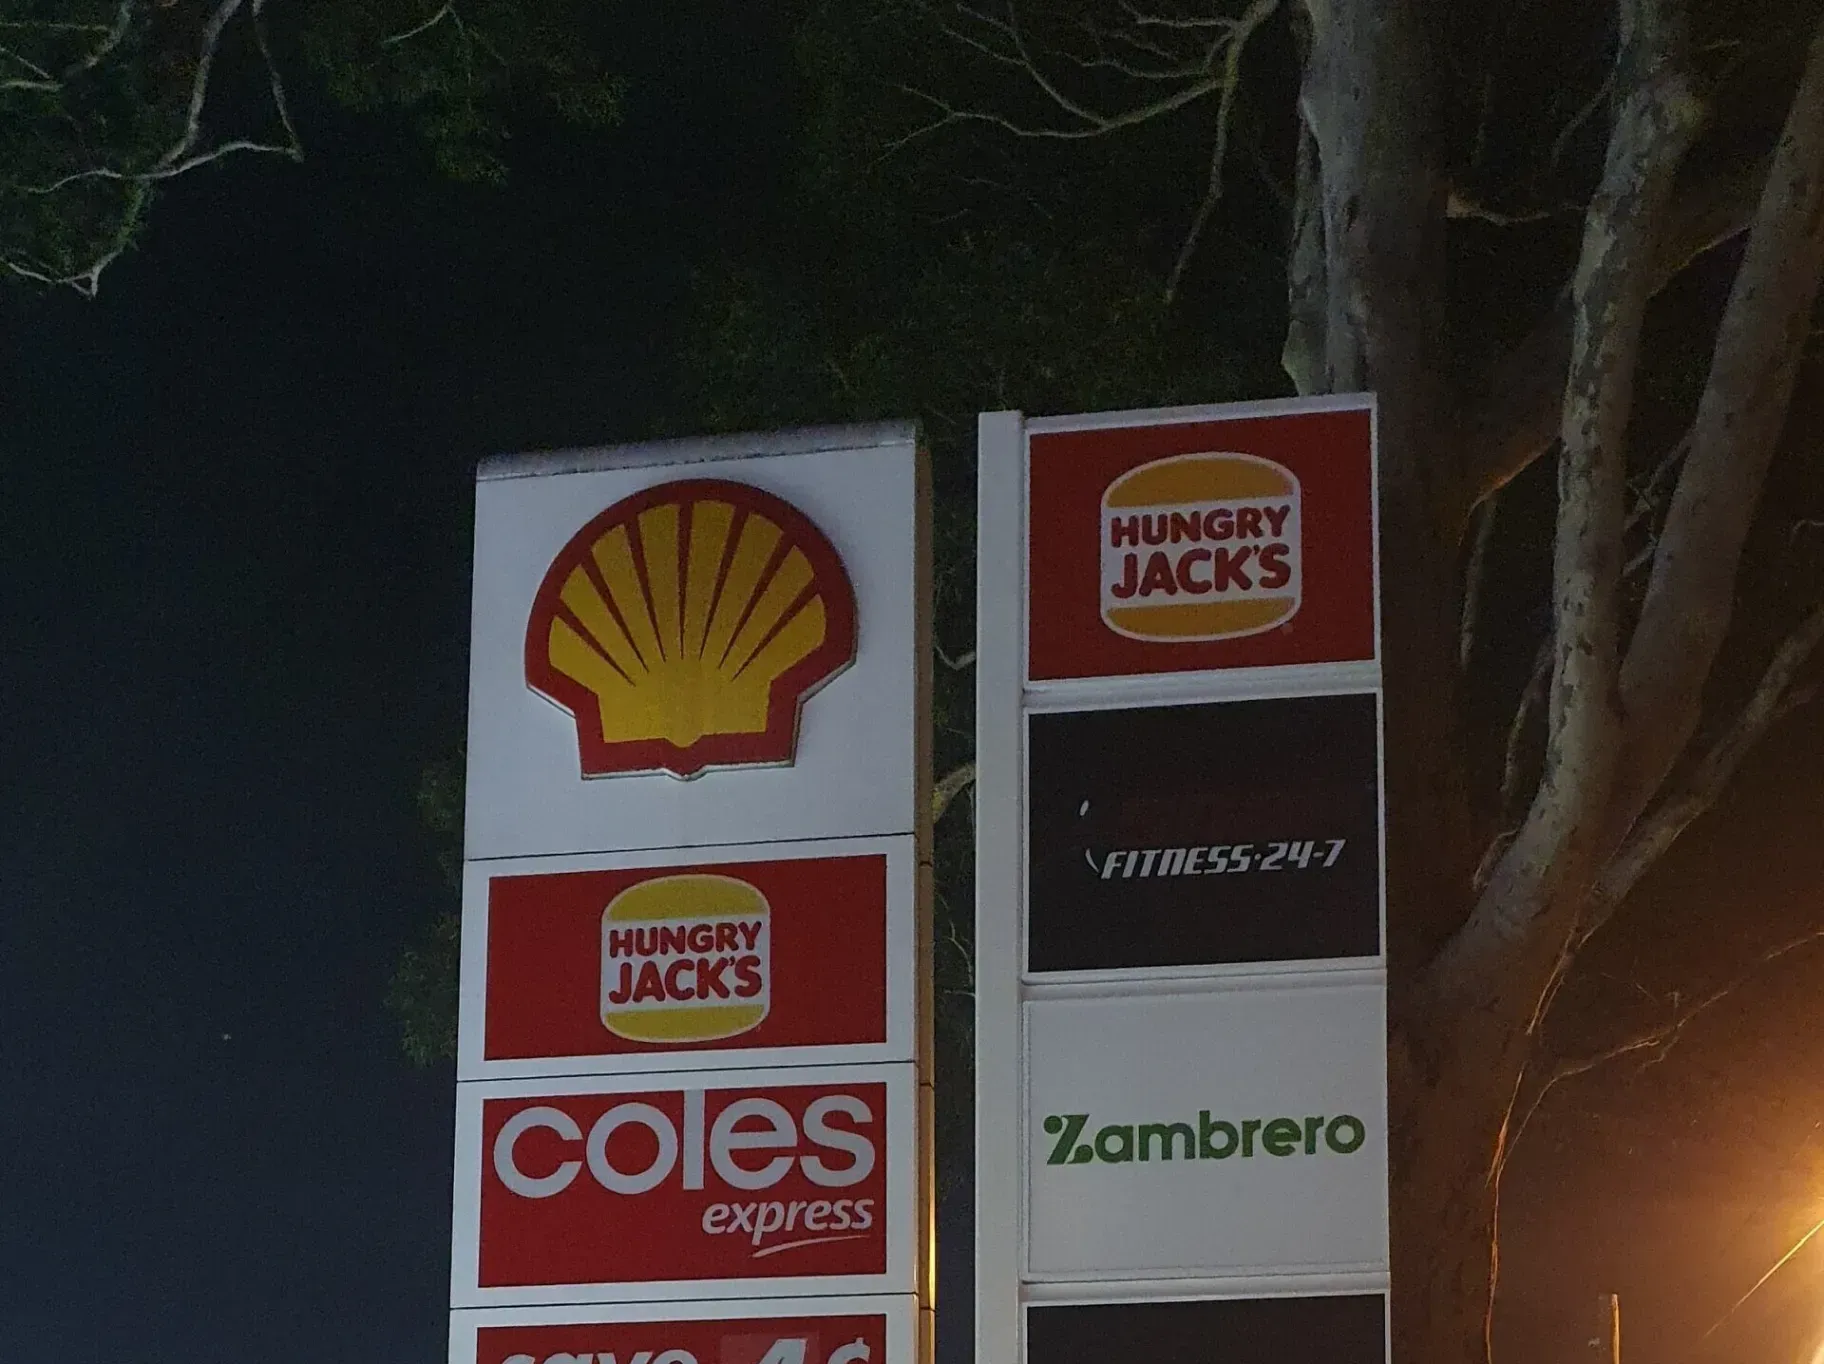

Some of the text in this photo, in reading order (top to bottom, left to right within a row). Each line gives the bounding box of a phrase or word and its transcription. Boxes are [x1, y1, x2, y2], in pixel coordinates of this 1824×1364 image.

[1110, 505, 1291, 548] HUNGRY
[1111, 543, 1292, 599] JACK'S
[609, 921, 762, 958] HUNGRY
[609, 954, 762, 1004] JACK'S
[493, 1090, 876, 1199] coles
[1043, 1109, 1366, 1166] Zambrero
[702, 1198, 874, 1246] express
